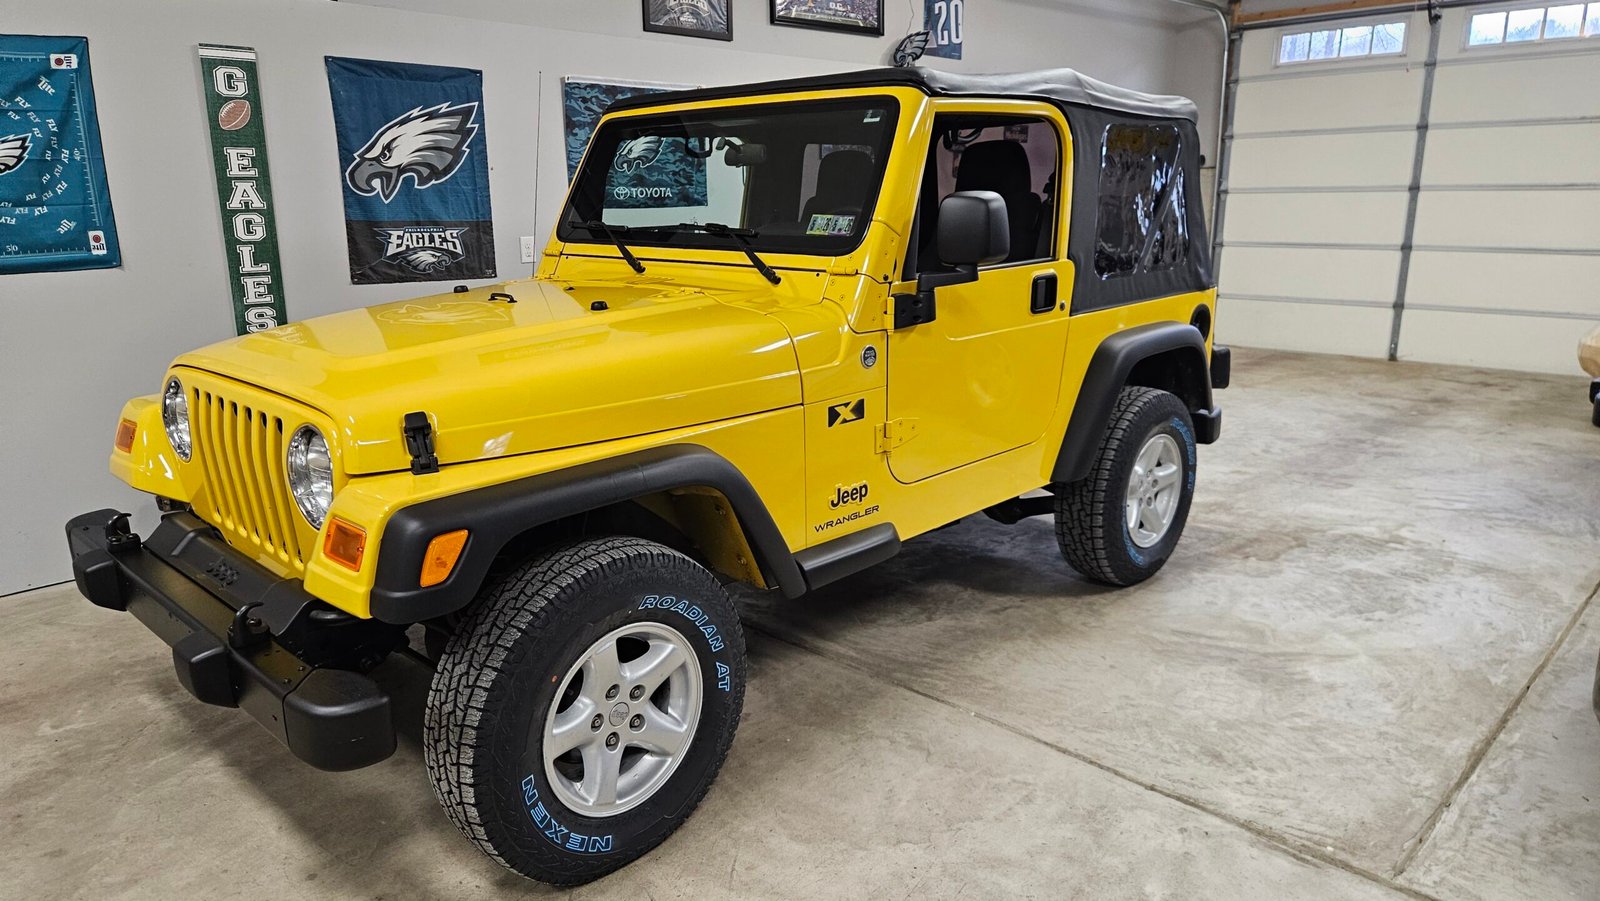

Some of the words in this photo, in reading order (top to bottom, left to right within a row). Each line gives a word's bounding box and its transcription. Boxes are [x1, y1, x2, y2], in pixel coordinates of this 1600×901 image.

[934, 0, 963, 45] 20
[38, 80, 55, 96] Lite
[14, 96, 31, 108] FLY
[7, 111, 21, 120] FLY
[27, 111, 41, 123] FLY
[46, 119, 59, 132] FLY
[32, 127, 43, 138] FLY
[50, 136, 59, 149] FLY
[61, 148, 70, 164] FLY
[53, 164, 63, 178] FLY
[41, 173, 51, 184] FLY
[55, 180, 68, 195] FLY
[631, 187, 673, 198] TOYOTA
[25, 193, 38, 201] FLY
[41, 190, 54, 201] FLY
[34, 205, 48, 216] FLY
[0, 216, 16, 225] FLY
[56, 219, 72, 234] Lite
[224, 146, 277, 333] EAGLES
[385, 229, 463, 257] EAGLES
[830, 483, 868, 508] Jeep
[814, 505, 880, 533] WRANGLER
[638, 595, 725, 652] ROADIAN
[716, 661, 731, 692] AT
[520, 774, 612, 852] NEXEN
